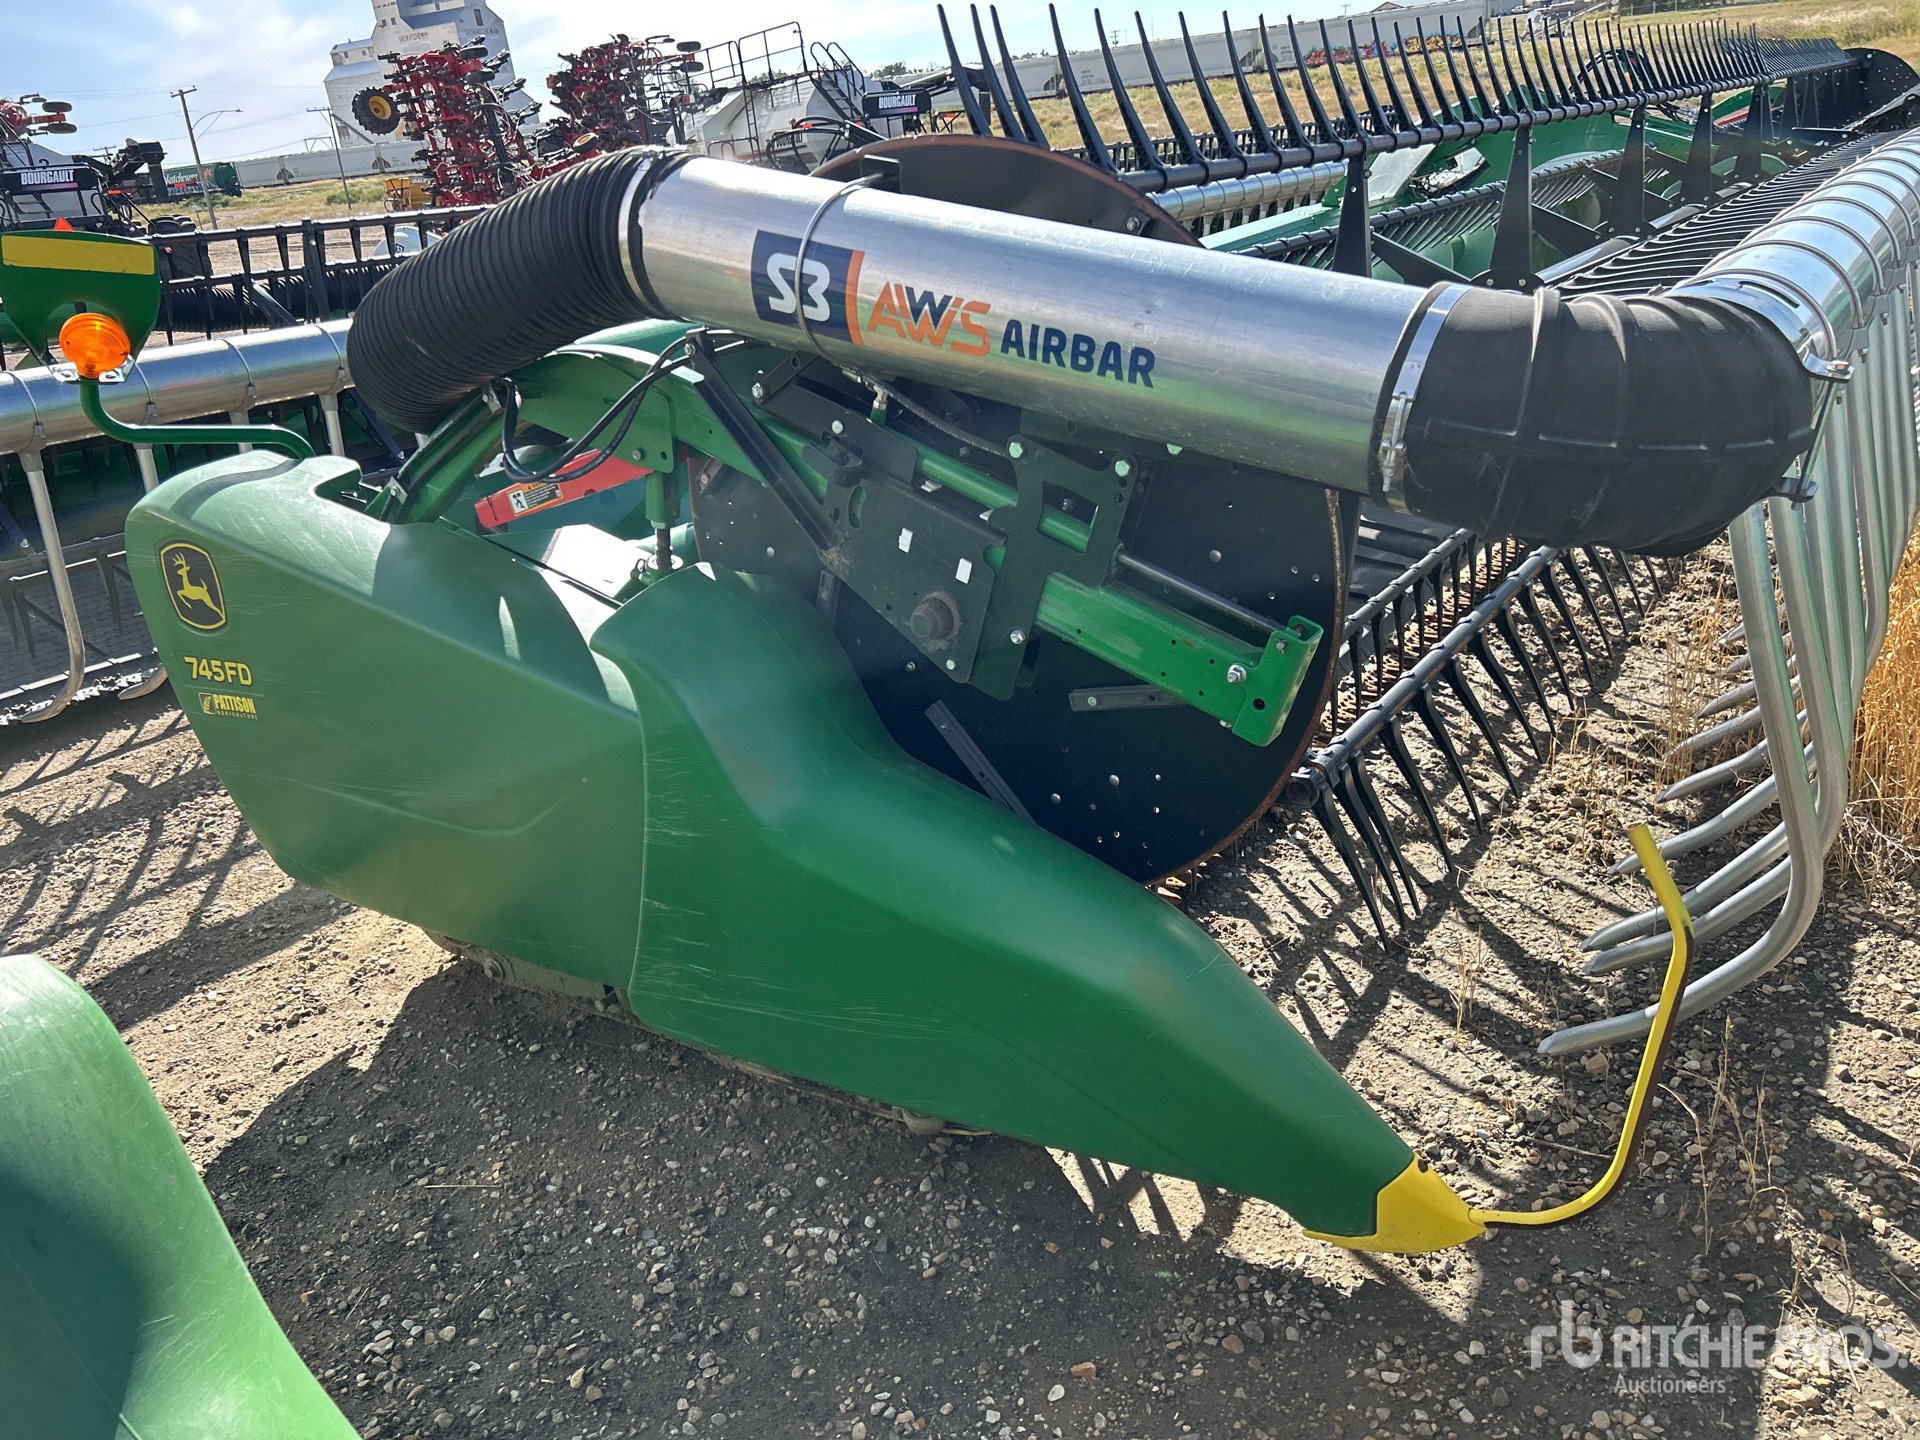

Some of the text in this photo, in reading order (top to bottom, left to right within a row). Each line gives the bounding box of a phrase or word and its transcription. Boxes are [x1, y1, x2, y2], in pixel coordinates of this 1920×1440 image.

[878, 94, 917, 109] BOURGAULT
[20, 169, 75, 186] BOURGAULT
[867, 281, 992, 358] AWS
[1000, 319, 1156, 389] AIRBAR
[183, 656, 253, 686] 745FD
[212, 693, 256, 715] PATTISON
[216, 710, 258, 720] AGRICULTURE
